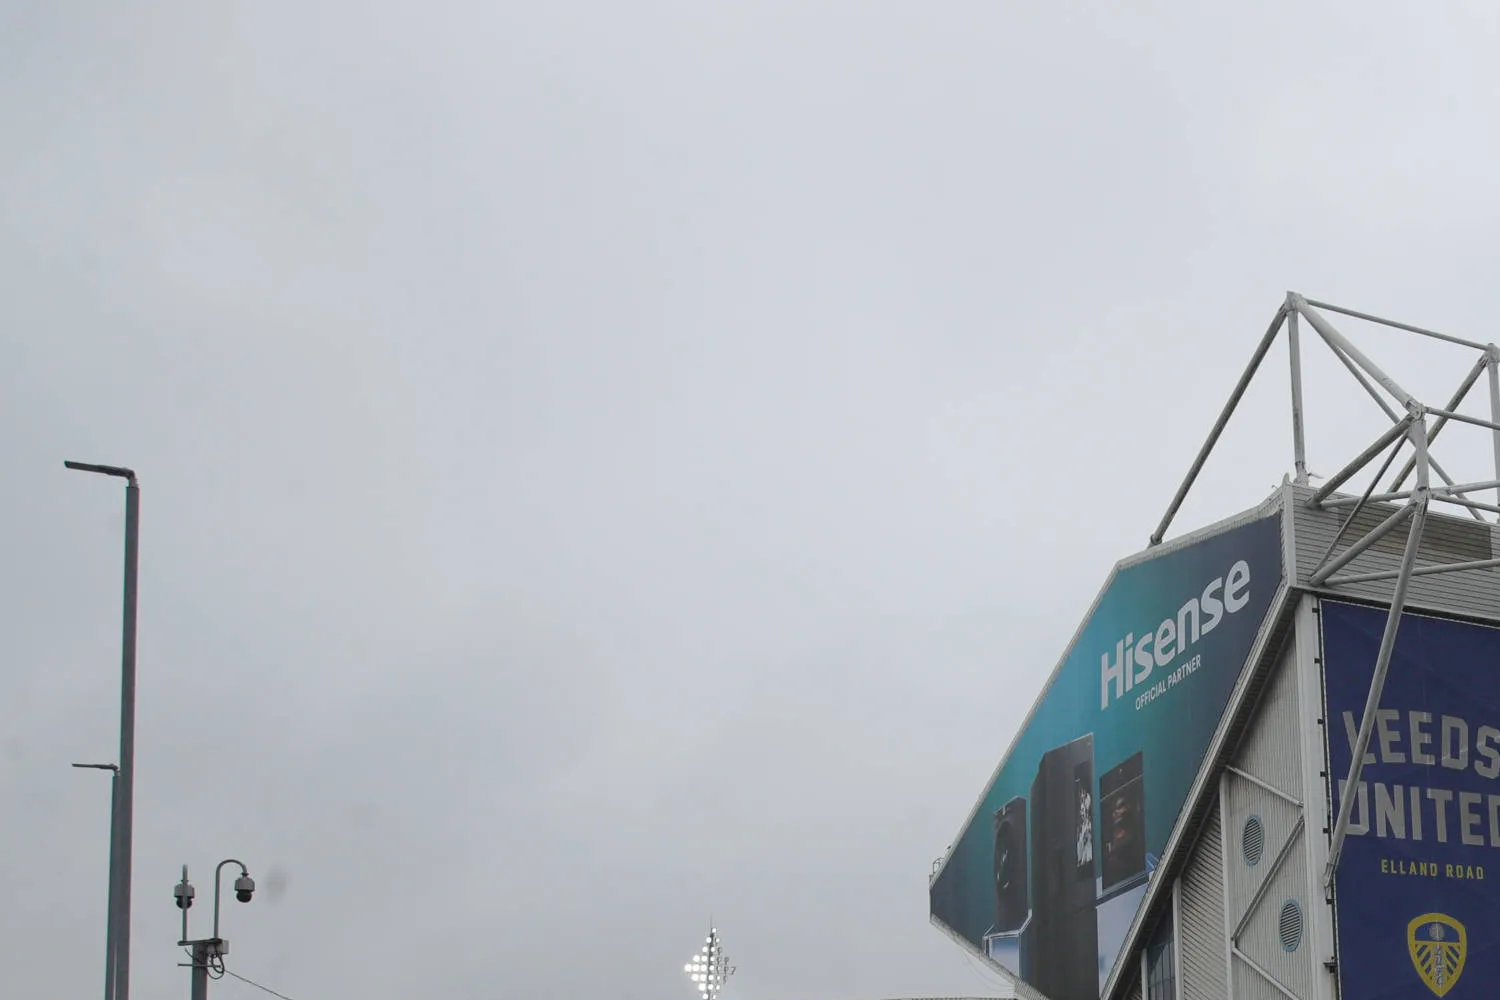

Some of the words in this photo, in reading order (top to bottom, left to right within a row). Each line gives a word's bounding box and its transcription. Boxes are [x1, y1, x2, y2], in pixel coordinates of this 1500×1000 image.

[1101, 559, 1250, 711] Hisense
[1135, 679, 1167, 711] OFFICIAL
[1167, 654, 1202, 689] PARTNER
[1381, 859, 1438, 877] ELLAND
[1446, 863, 1485, 880] ROAD
